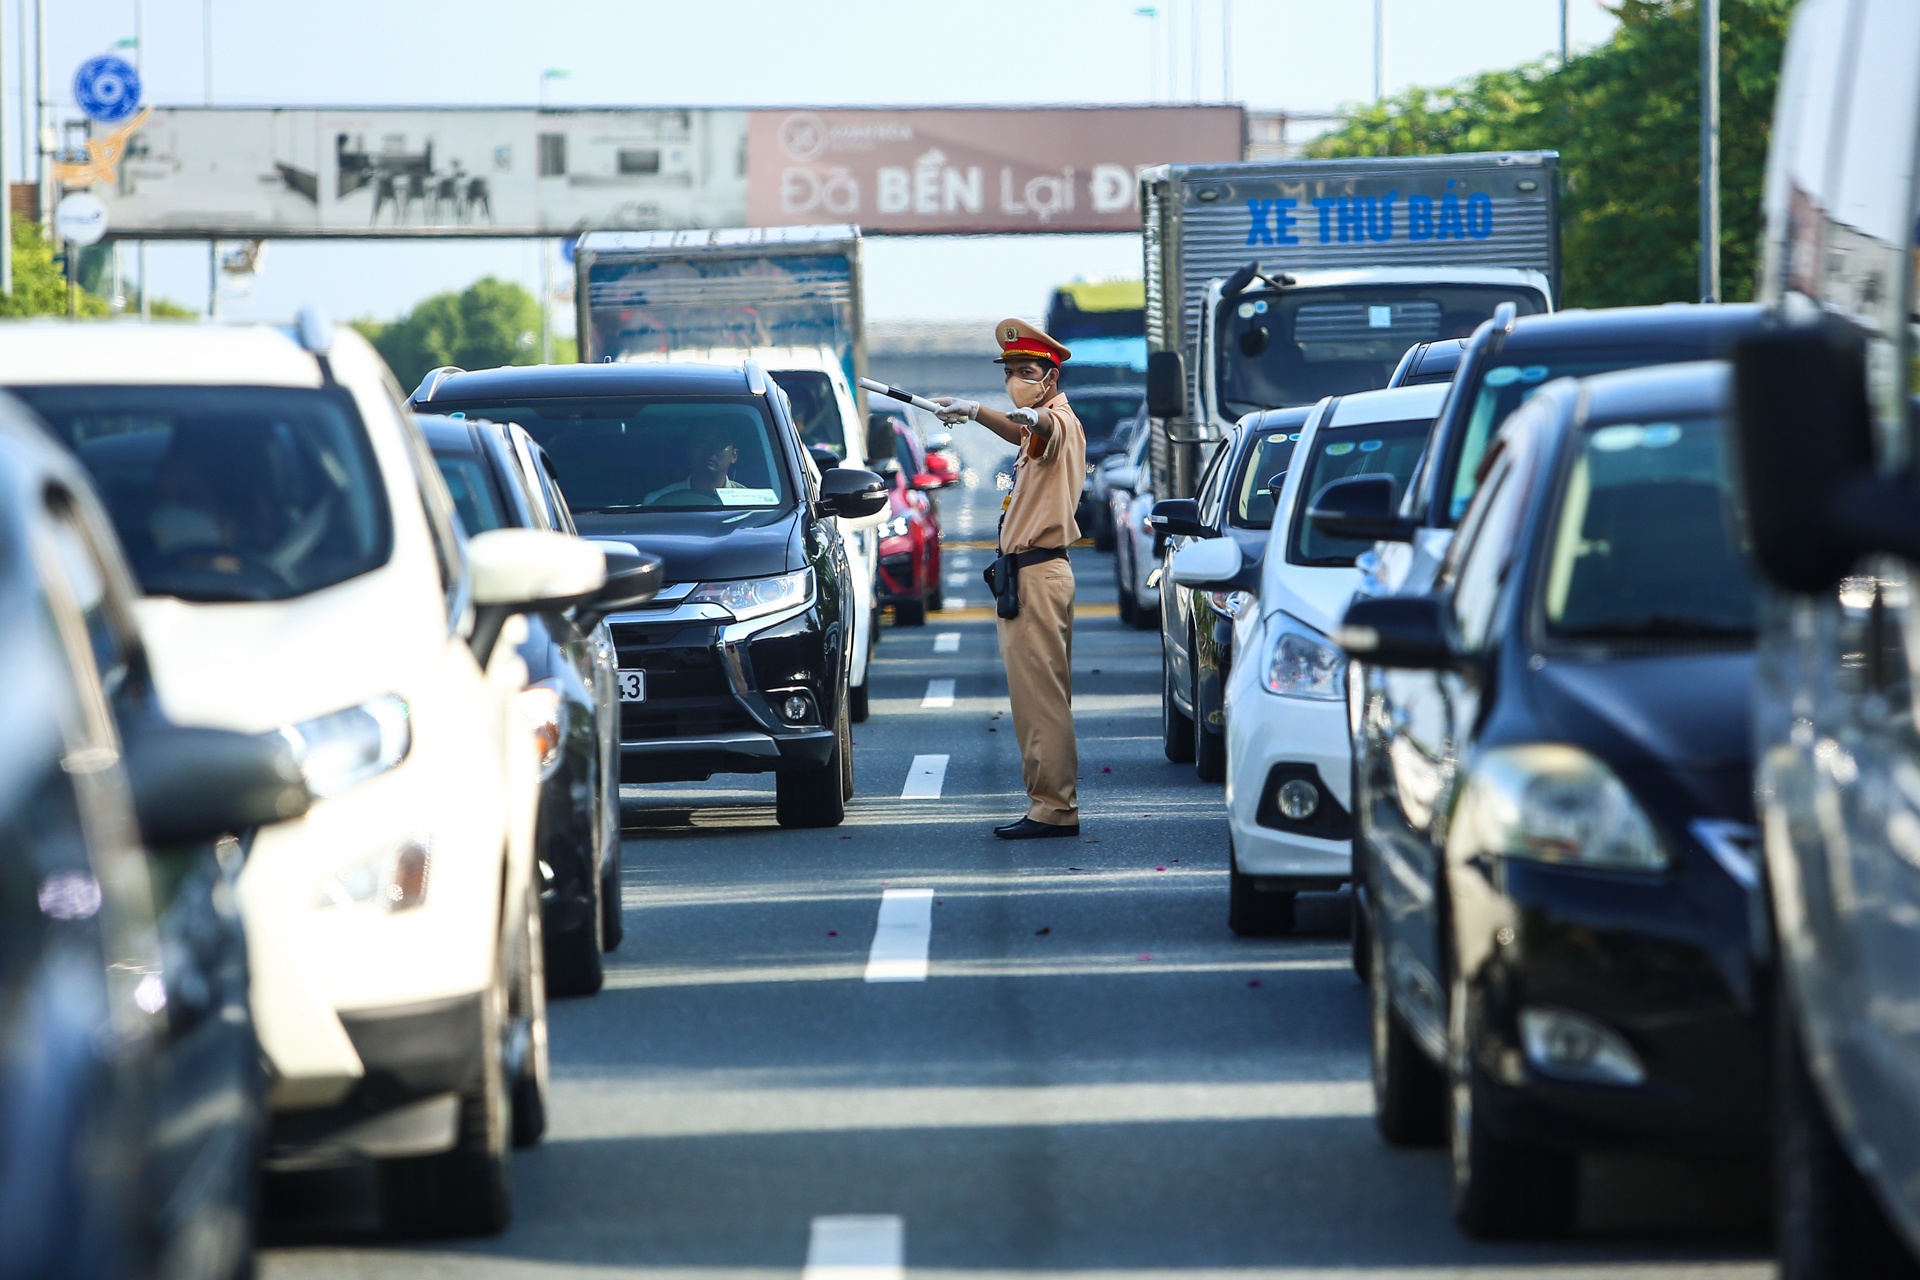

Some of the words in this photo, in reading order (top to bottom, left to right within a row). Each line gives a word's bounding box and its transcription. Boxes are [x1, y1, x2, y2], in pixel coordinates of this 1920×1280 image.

[782, 167, 860, 214] Đã
[1000, 165, 1074, 222] Lại
[1246, 199, 1299, 245] XE
[1313, 189, 1398, 244] THƯ
[1408, 179, 1493, 241] BÁO
